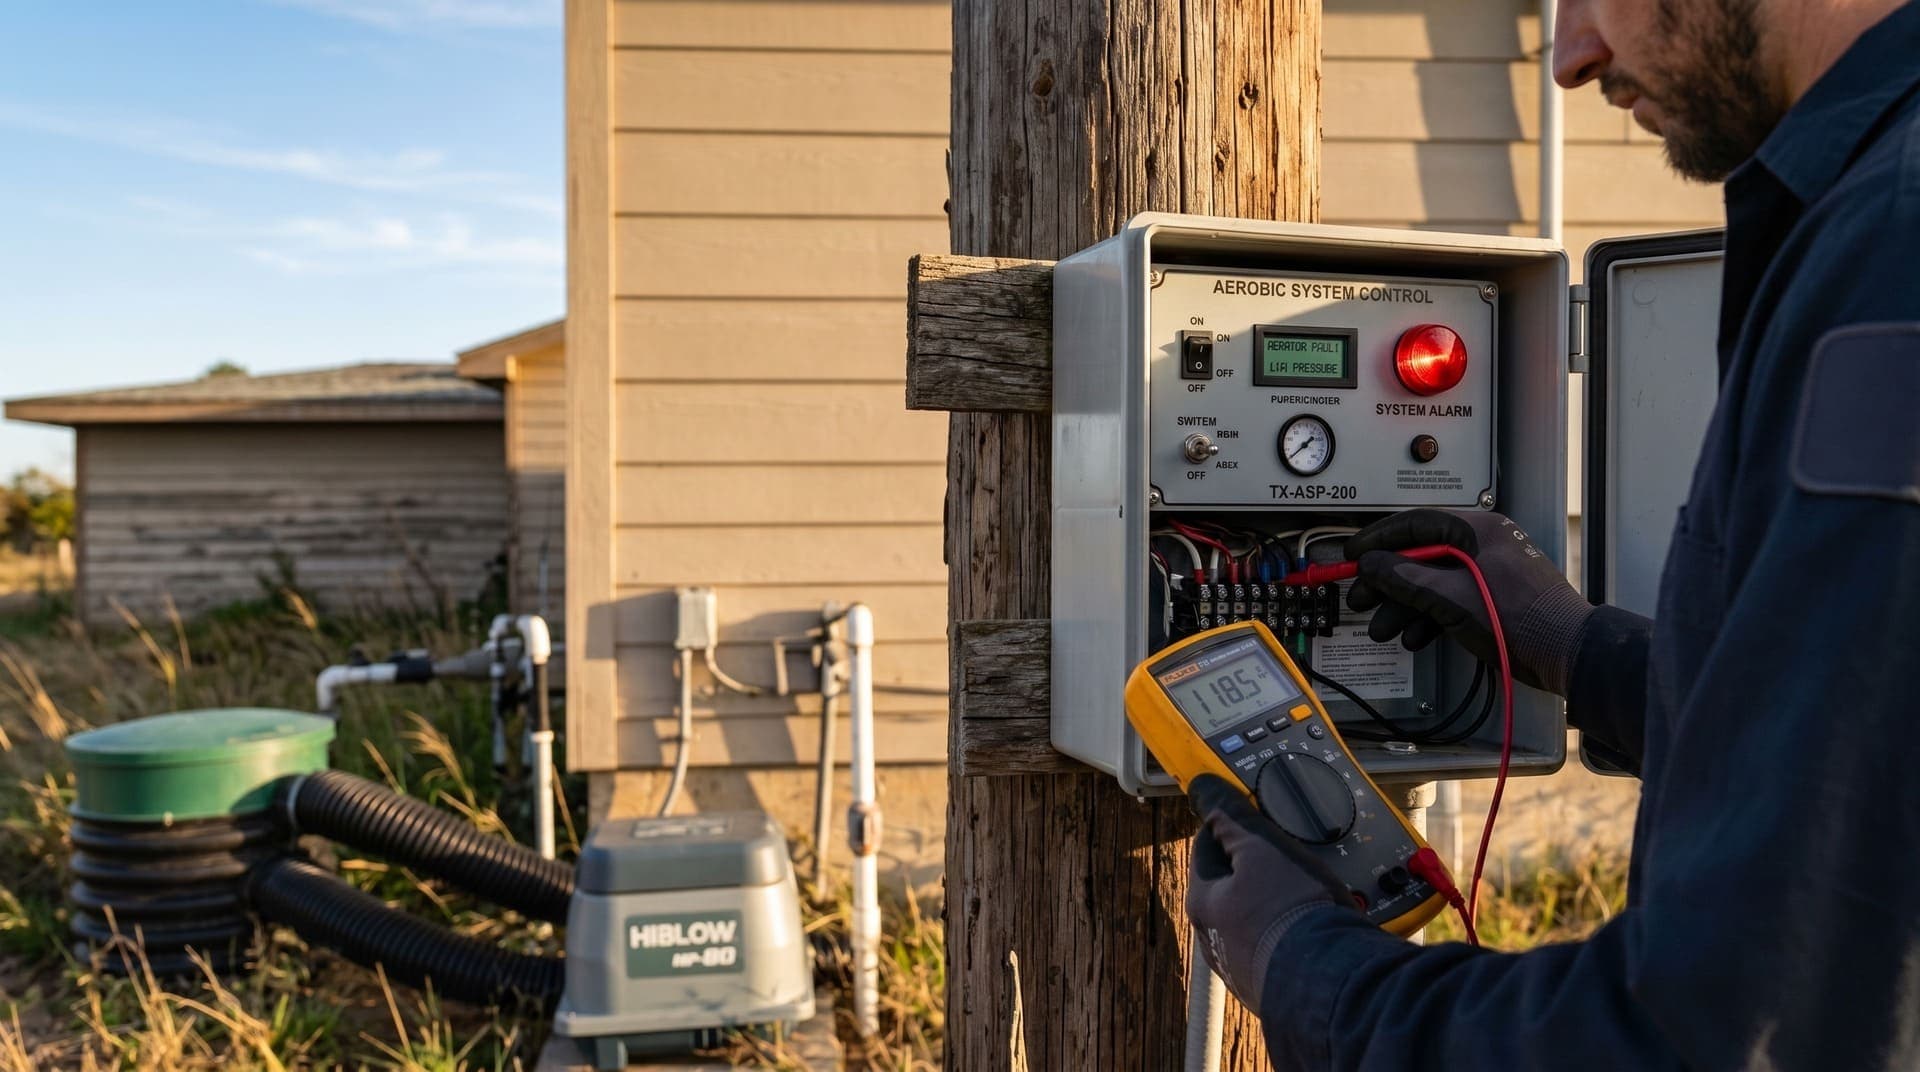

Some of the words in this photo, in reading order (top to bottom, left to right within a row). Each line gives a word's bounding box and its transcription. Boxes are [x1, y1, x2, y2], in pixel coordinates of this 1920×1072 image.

[1213, 279, 1286, 297] AEROBIC
[1291, 283, 1355, 300] SYSTEM
[1359, 286, 1433, 304] CONTROL
[1190, 316, 1204, 326] ON
[1216, 333, 1231, 343] ON
[1267, 340, 1308, 352] AERATOR
[1216, 368, 1235, 378] OFF
[1187, 383, 1206, 393] OFF
[1375, 403, 1426, 417] SYSTEM
[1429, 404, 1473, 417] ALARM
[1177, 416, 1217, 426] SWITEM
[1186, 470, 1206, 480] OFF
[1268, 484, 1357, 500] TX-ASP-200
[629, 919, 737, 950] HIBLOW
